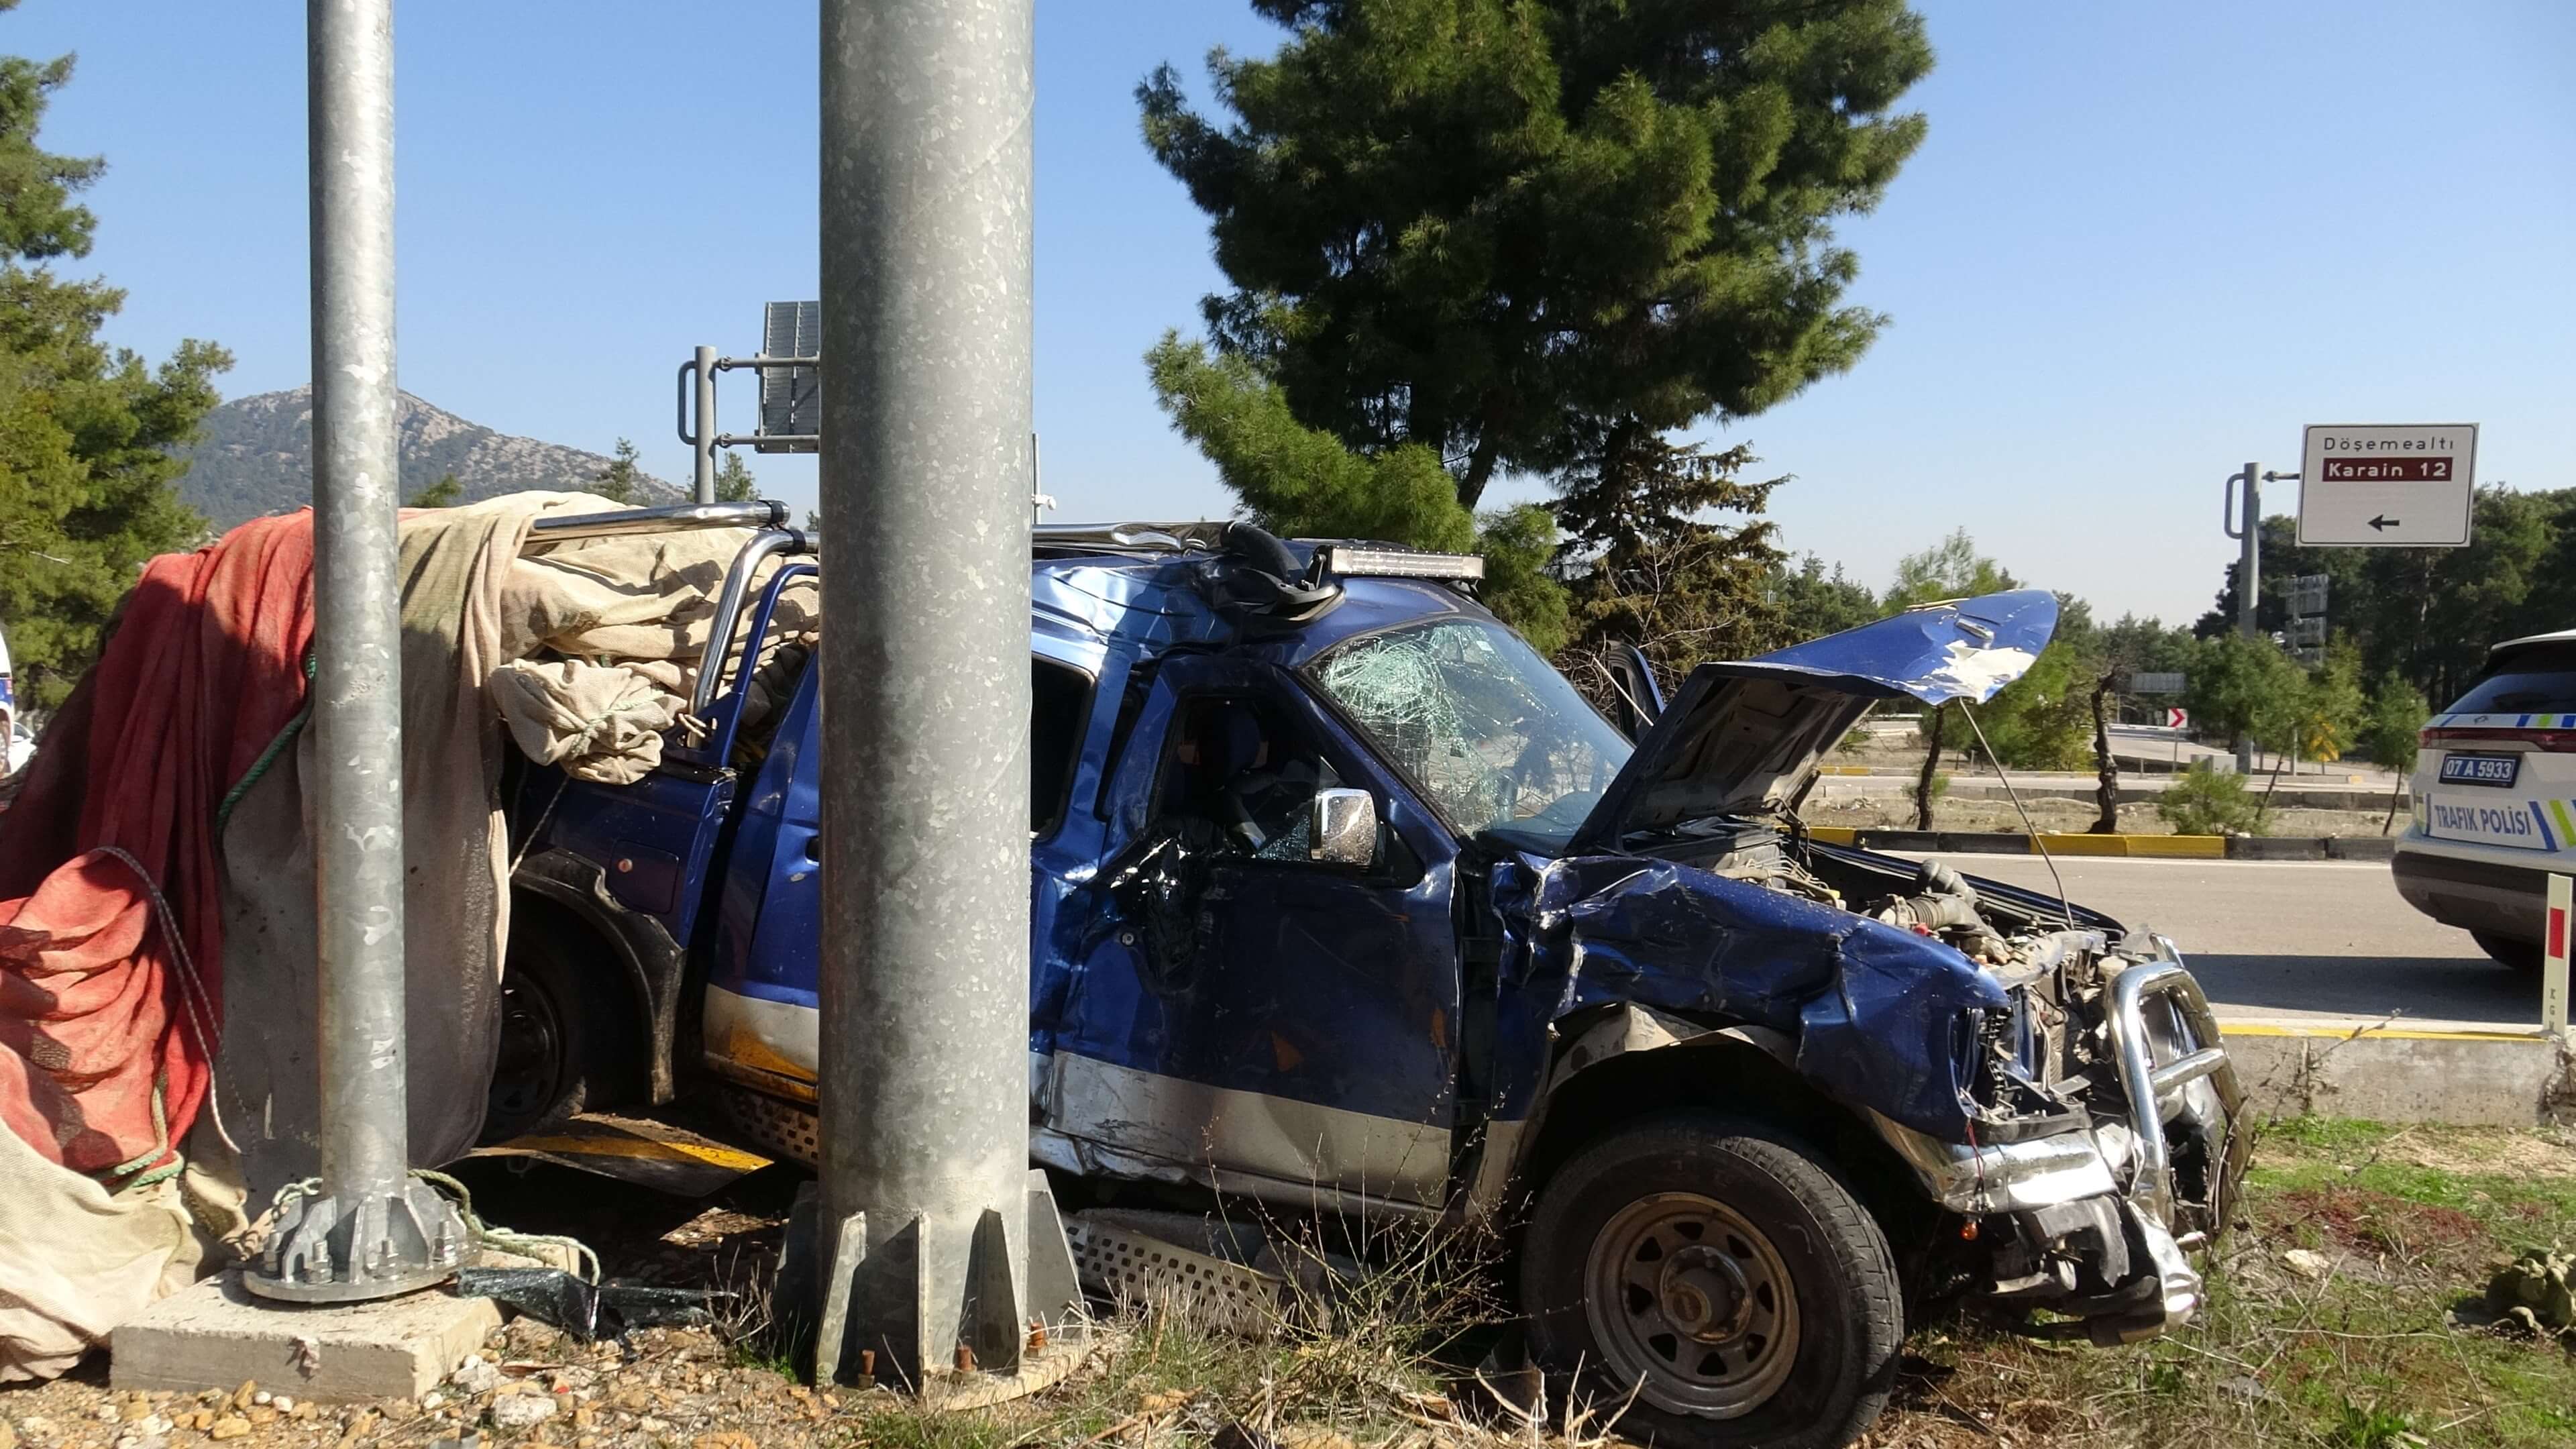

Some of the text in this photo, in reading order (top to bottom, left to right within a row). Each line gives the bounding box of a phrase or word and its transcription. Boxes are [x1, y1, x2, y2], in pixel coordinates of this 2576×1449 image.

[2324, 436, 2453, 452] Döşemealtı
[2328, 462, 2447, 477] Karain 12
[2446, 759, 2512, 778] 07 A 5933
